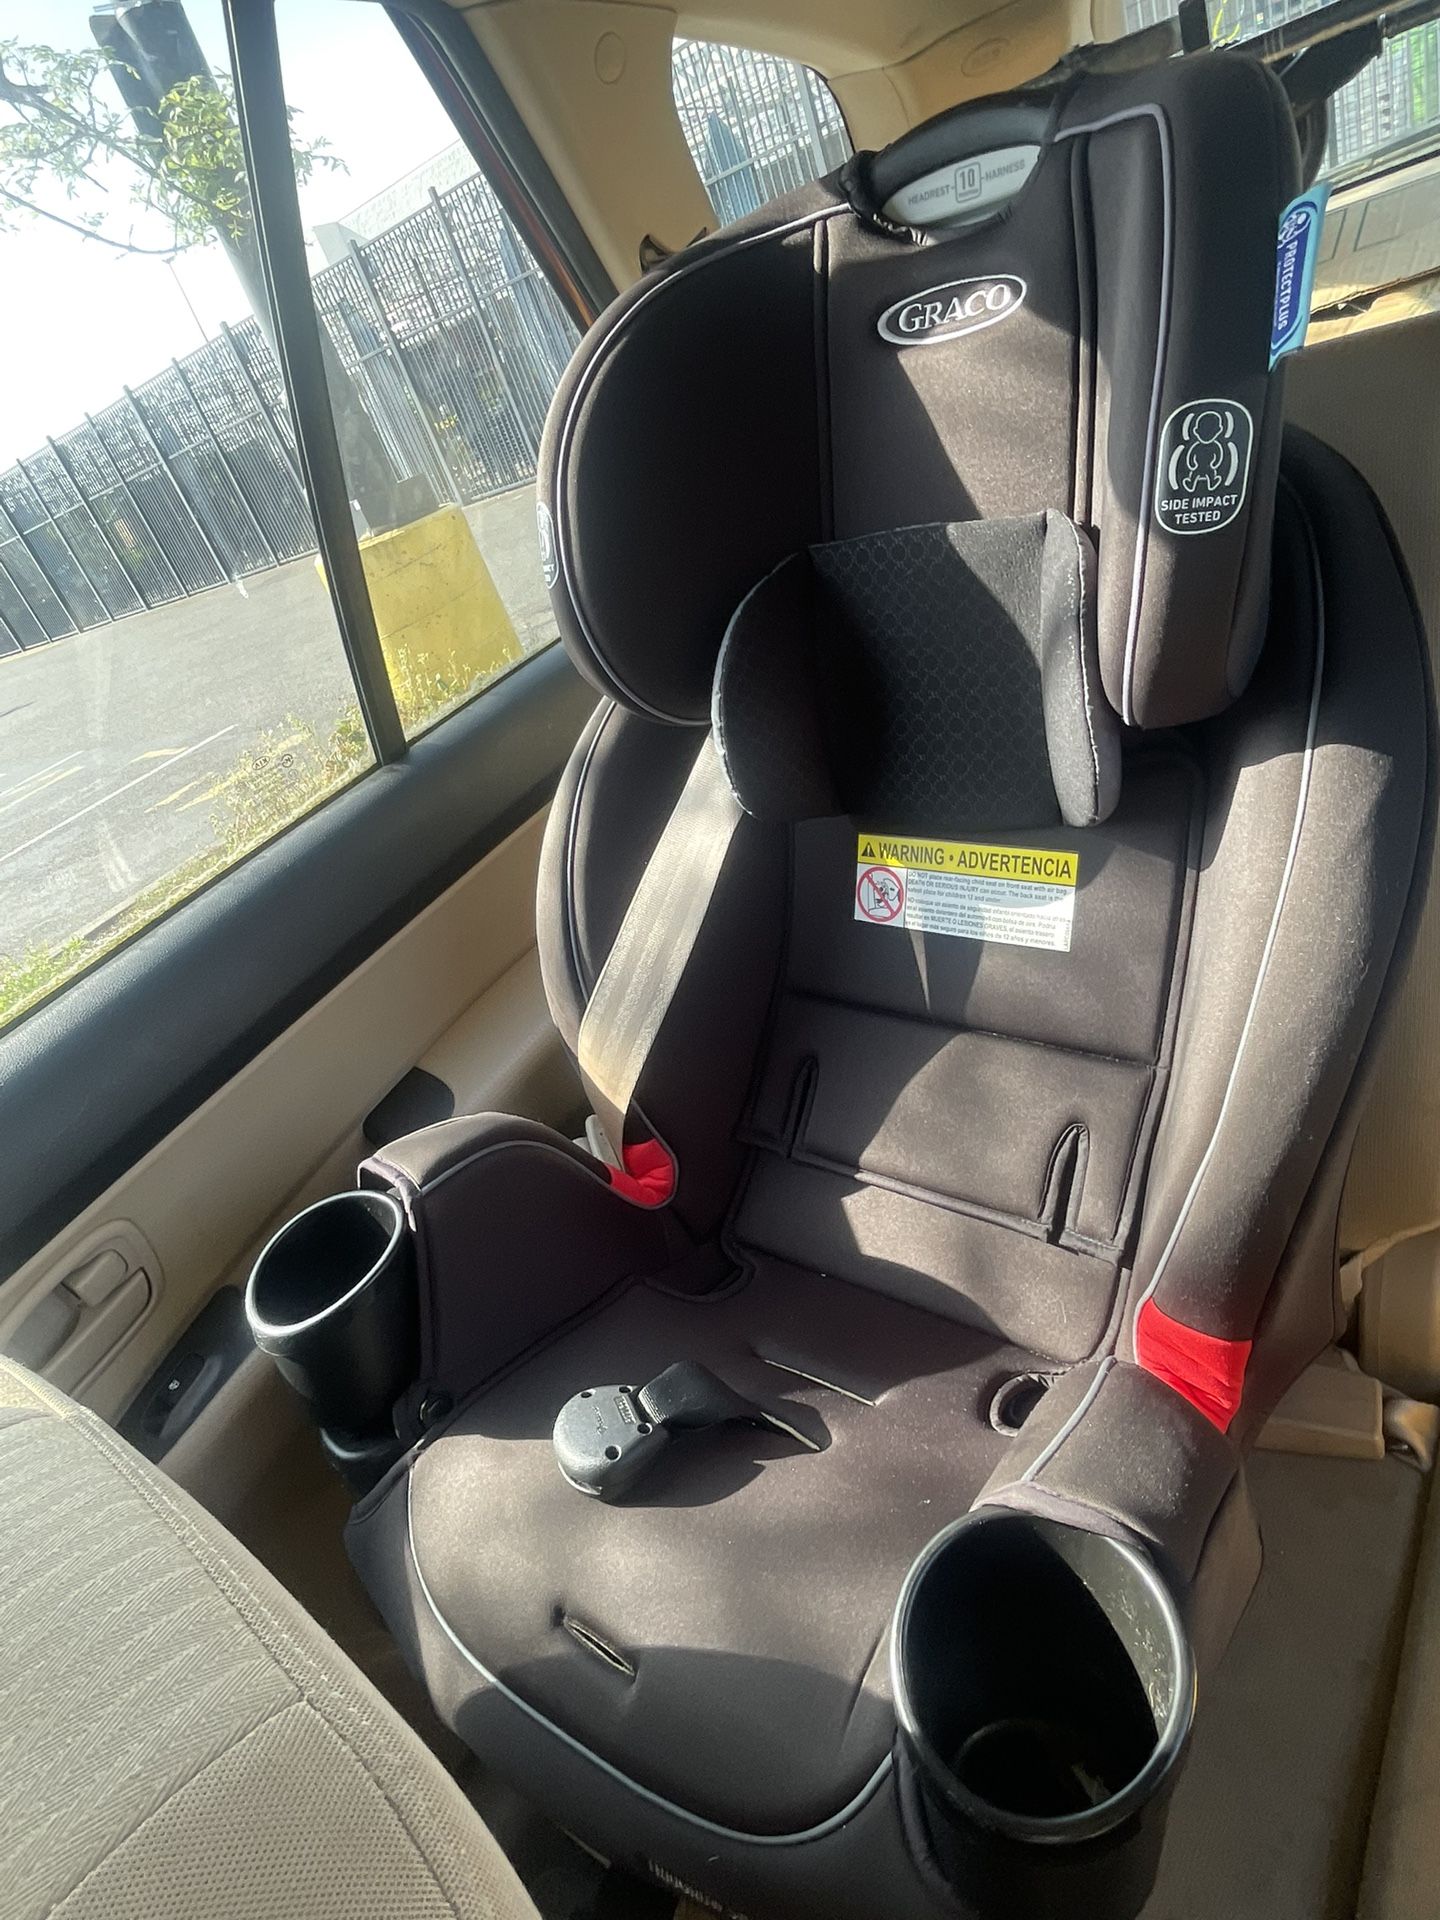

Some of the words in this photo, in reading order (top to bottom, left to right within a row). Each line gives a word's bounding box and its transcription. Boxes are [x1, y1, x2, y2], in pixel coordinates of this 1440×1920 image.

[959, 168, 975, 190] 10
[985, 159, 1025, 182] HARNESS
[908, 184, 951, 205] HEADREST
[899, 284, 1011, 332] GRACO
[1161, 498, 1190, 511] SIDE
[1192, 494, 1238, 509] IMPACT
[1175, 510, 1221, 524] TESTED
[879, 842, 945, 865] WARNING
[957, 850, 1071, 878] ADVERTENCIA
